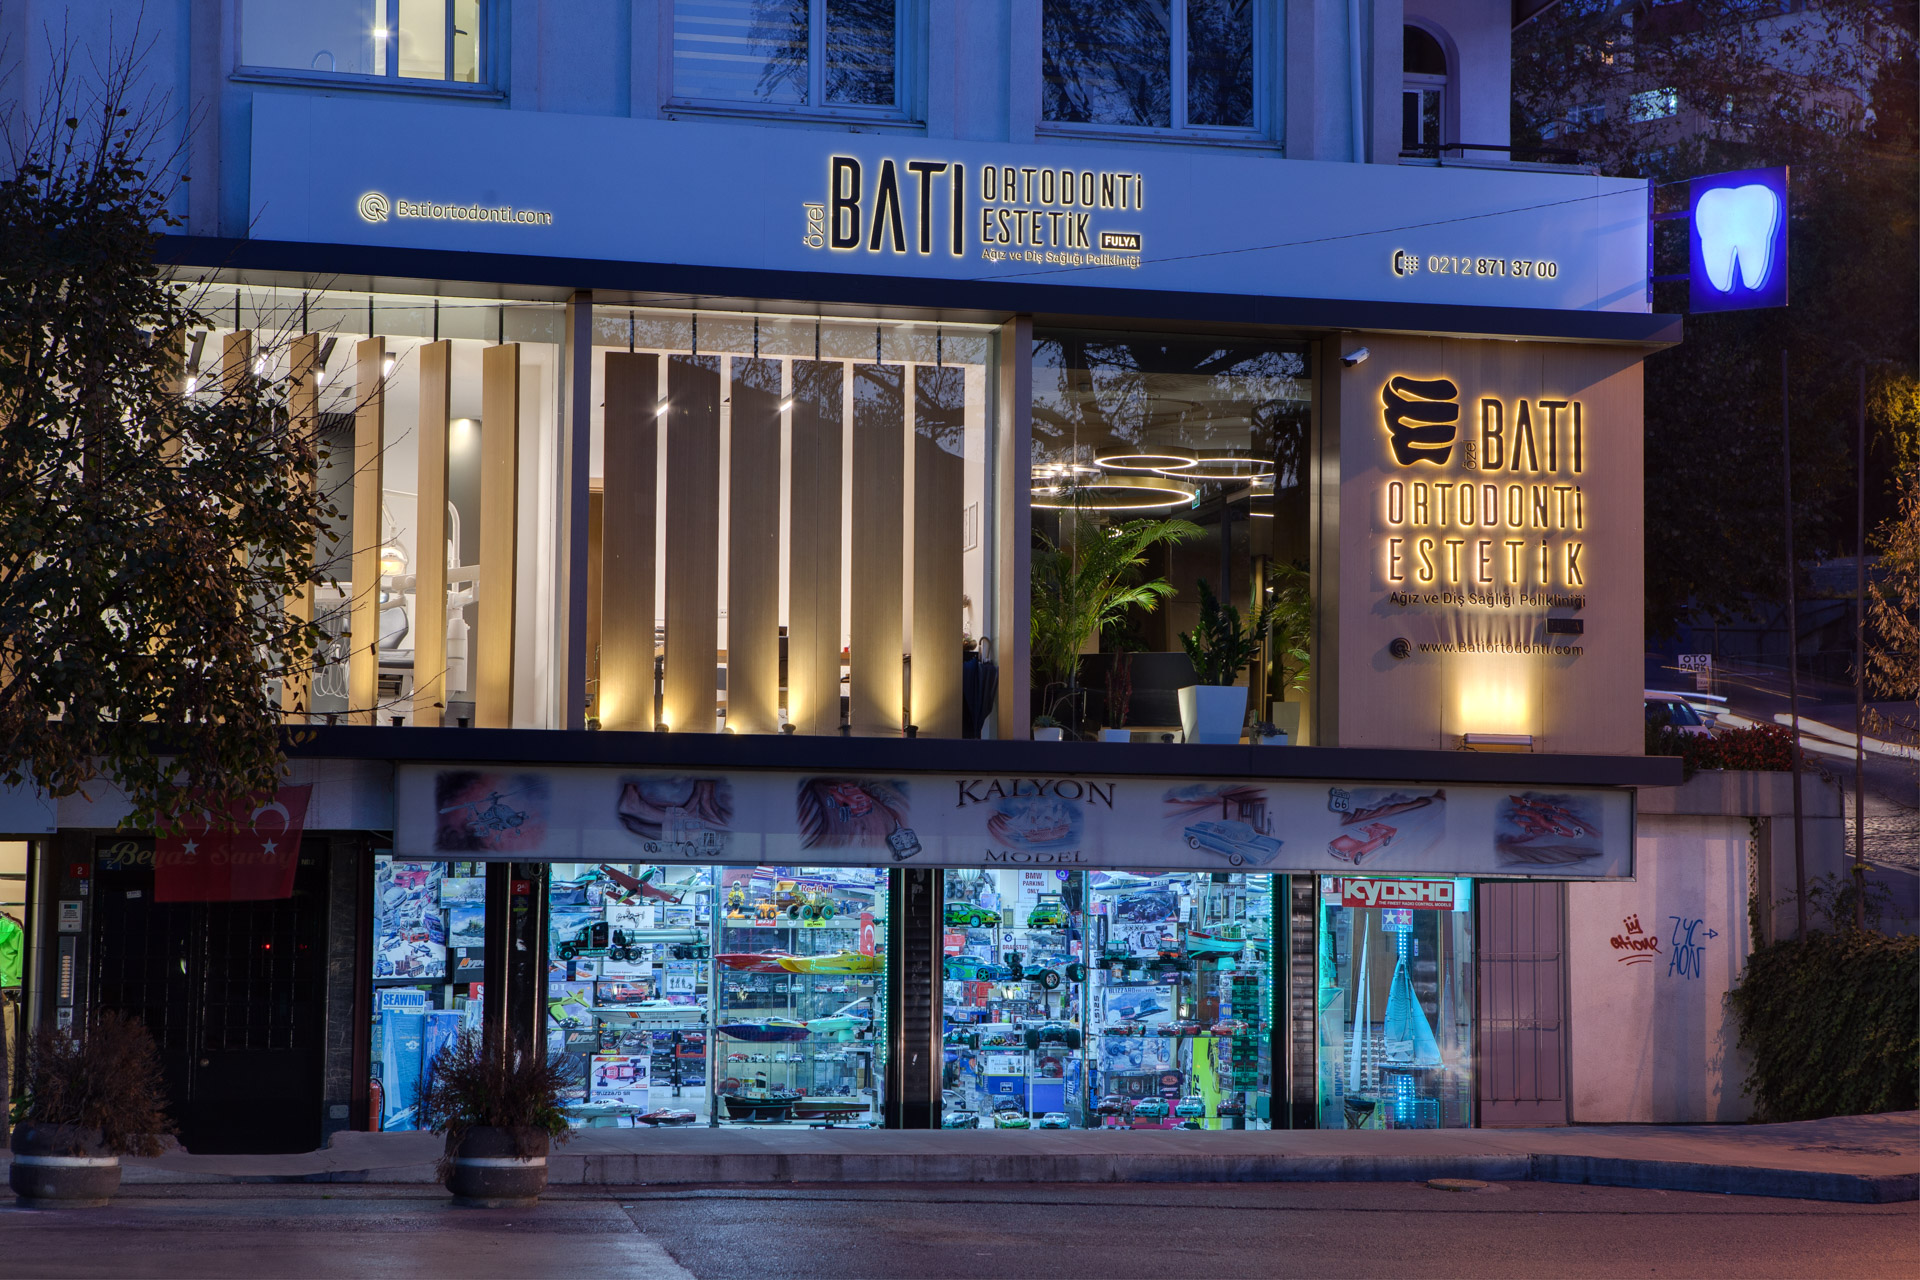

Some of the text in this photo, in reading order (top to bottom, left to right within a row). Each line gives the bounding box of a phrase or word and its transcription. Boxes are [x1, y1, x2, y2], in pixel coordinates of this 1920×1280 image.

[398, 200, 552, 224] Batiortodonti.com
[830, 156, 964, 256] BATI
[1104, 235, 1137, 248] FULYA
[981, 248, 1141, 269] Ağız ve Diş Sağlığı Polikliniği
[1428, 256, 1557, 278] 0212 871 37 00
[1480, 398, 1582, 473] BATI
[1390, 591, 1586, 610] Ağız ve Diş Sağlığı Polikliniği
[1418, 642, 1584, 656] www.Batiortodonti.com
[1680, 663, 1707, 673] PARK
[1683, 655, 1707, 663] OTO
[956, 778, 1117, 810] KALYON
[984, 849, 1089, 863] MODEL
[77, 867, 83, 875] 2
[1344, 880, 1453, 905] KYOSHO
[383, 993, 424, 1006] SEAWIND
